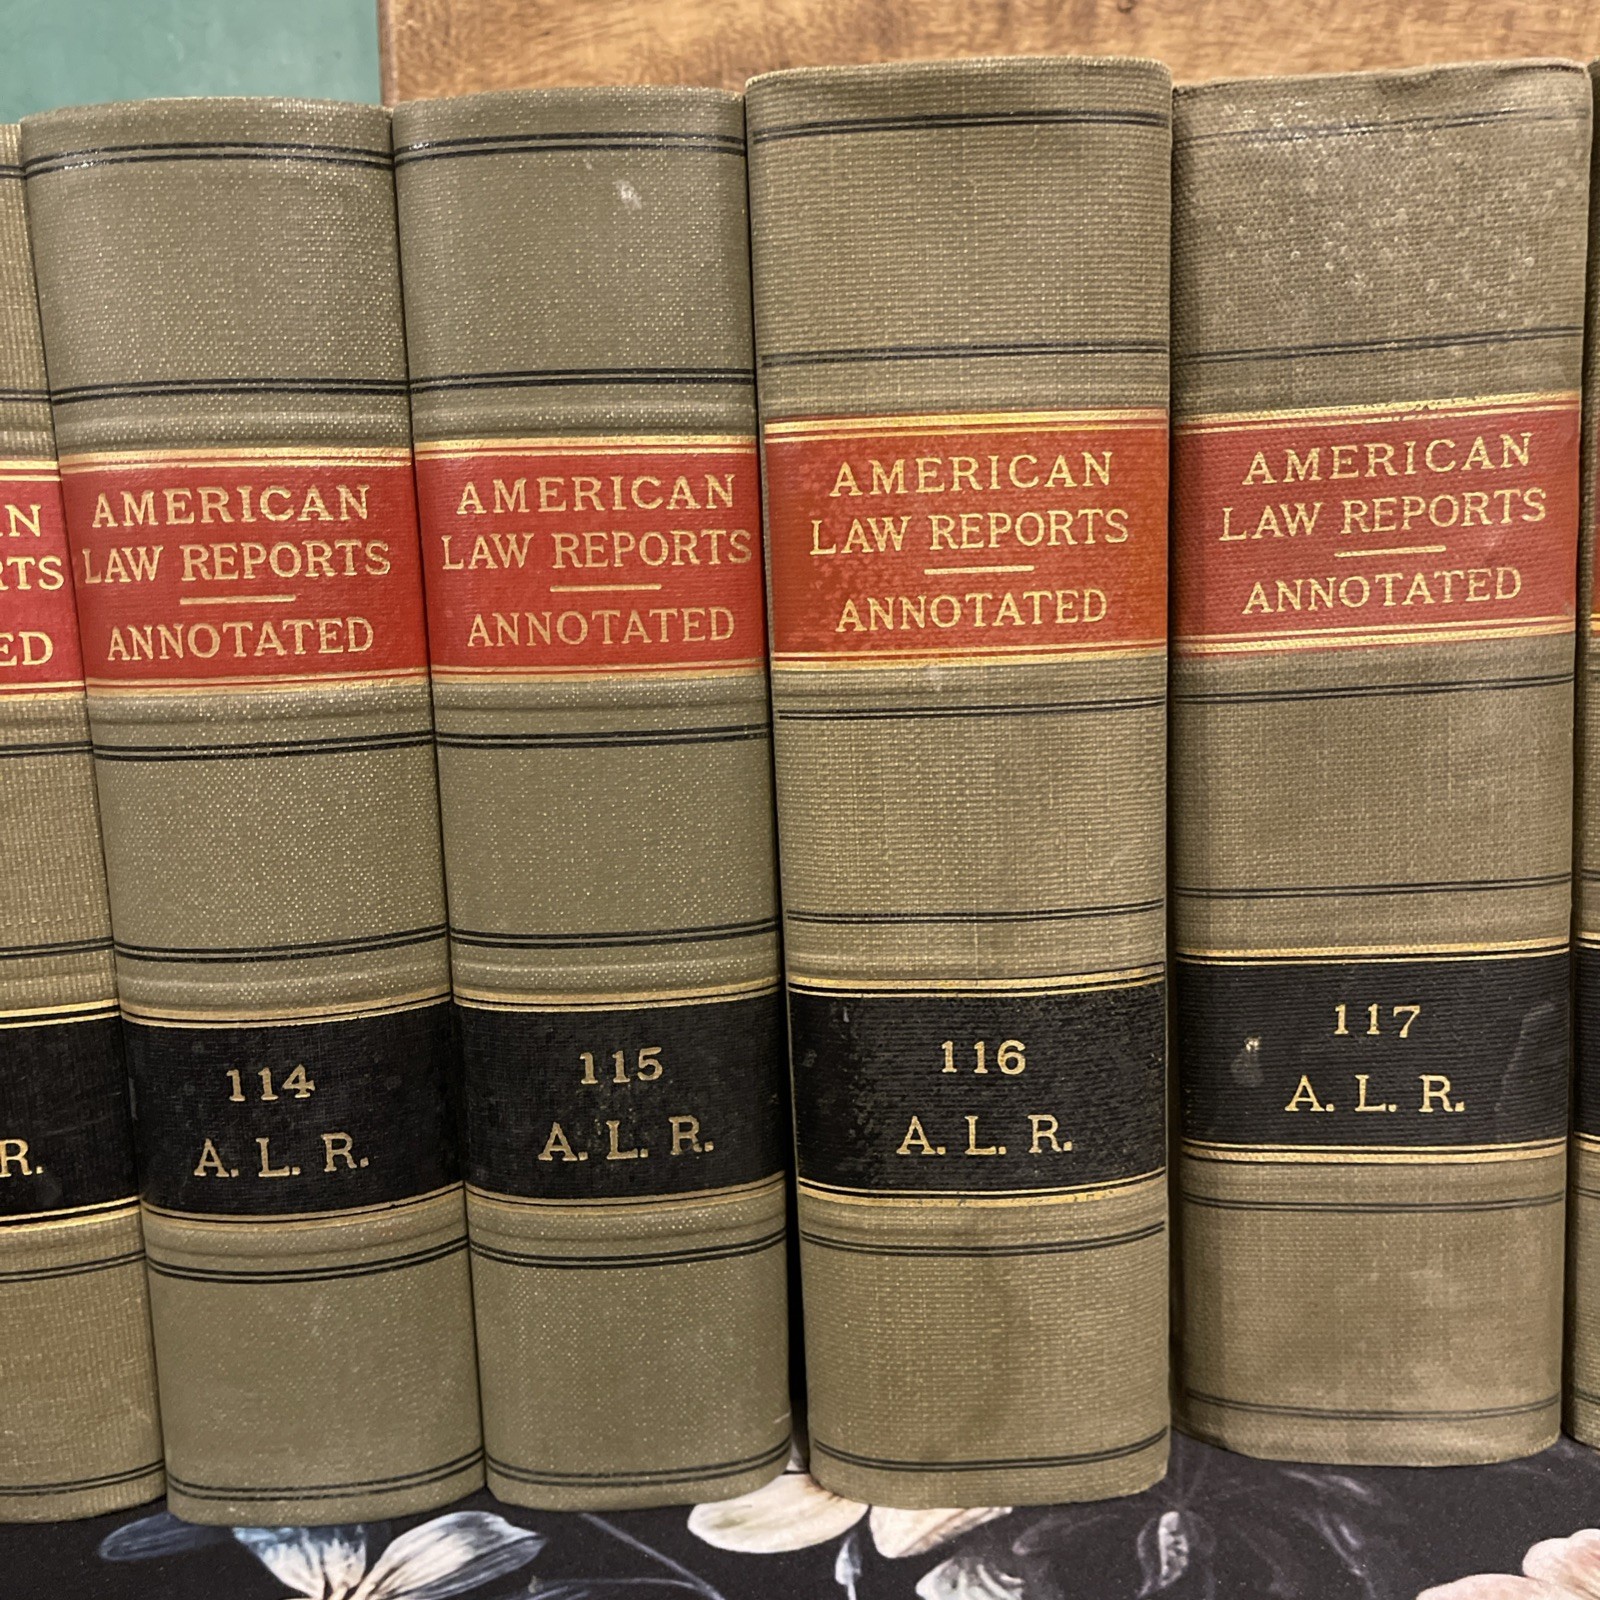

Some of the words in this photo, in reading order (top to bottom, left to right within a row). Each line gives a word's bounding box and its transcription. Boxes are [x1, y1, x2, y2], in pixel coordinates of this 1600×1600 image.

[829, 451, 1113, 497] AMERICAN
[1242, 432, 1533, 485] AMERICAN
[92, 484, 370, 528] AMERICAN
[456, 473, 735, 515] AMERICAN
[1219, 502, 1323, 542] LAW
[1340, 487, 1547, 535] REPORTS
[441, 532, 534, 570] LAW
[551, 529, 752, 569] REPORTS
[809, 515, 912, 556] LAW
[928, 508, 1130, 551] REPORTS
[82, 545, 164, 585] LAW
[180, 539, 392, 581] REPORTS
[835, 588, 1107, 633] ANNOTATED
[1242, 567, 1522, 615] ANNOTATED
[107, 616, 374, 662] ANNOTATED
[467, 607, 735, 647] ANNOTATED
[1334, 1003, 1421, 1039] 117
[579, 1046, 663, 1085] 115
[941, 1039, 1027, 1075] 116
[226, 1064, 315, 1102] 114
[1284, 1074, 1335, 1112] A.
[1354, 1074, 1397, 1112] L.
[1418, 1074, 1466, 1112] R.
[194, 1138, 240, 1177] A.
[255, 1137, 301, 1178] L.
[321, 1131, 370, 1172] R.
[537, 1121, 589, 1161] A.
[606, 1120, 649, 1160] L.
[669, 1115, 714, 1155] R.
[896, 1115, 946, 1155] A.
[964, 1115, 1007, 1155] L.
[1027, 1114, 1073, 1153] R.
[0, 1138, 44, 1178] R.
